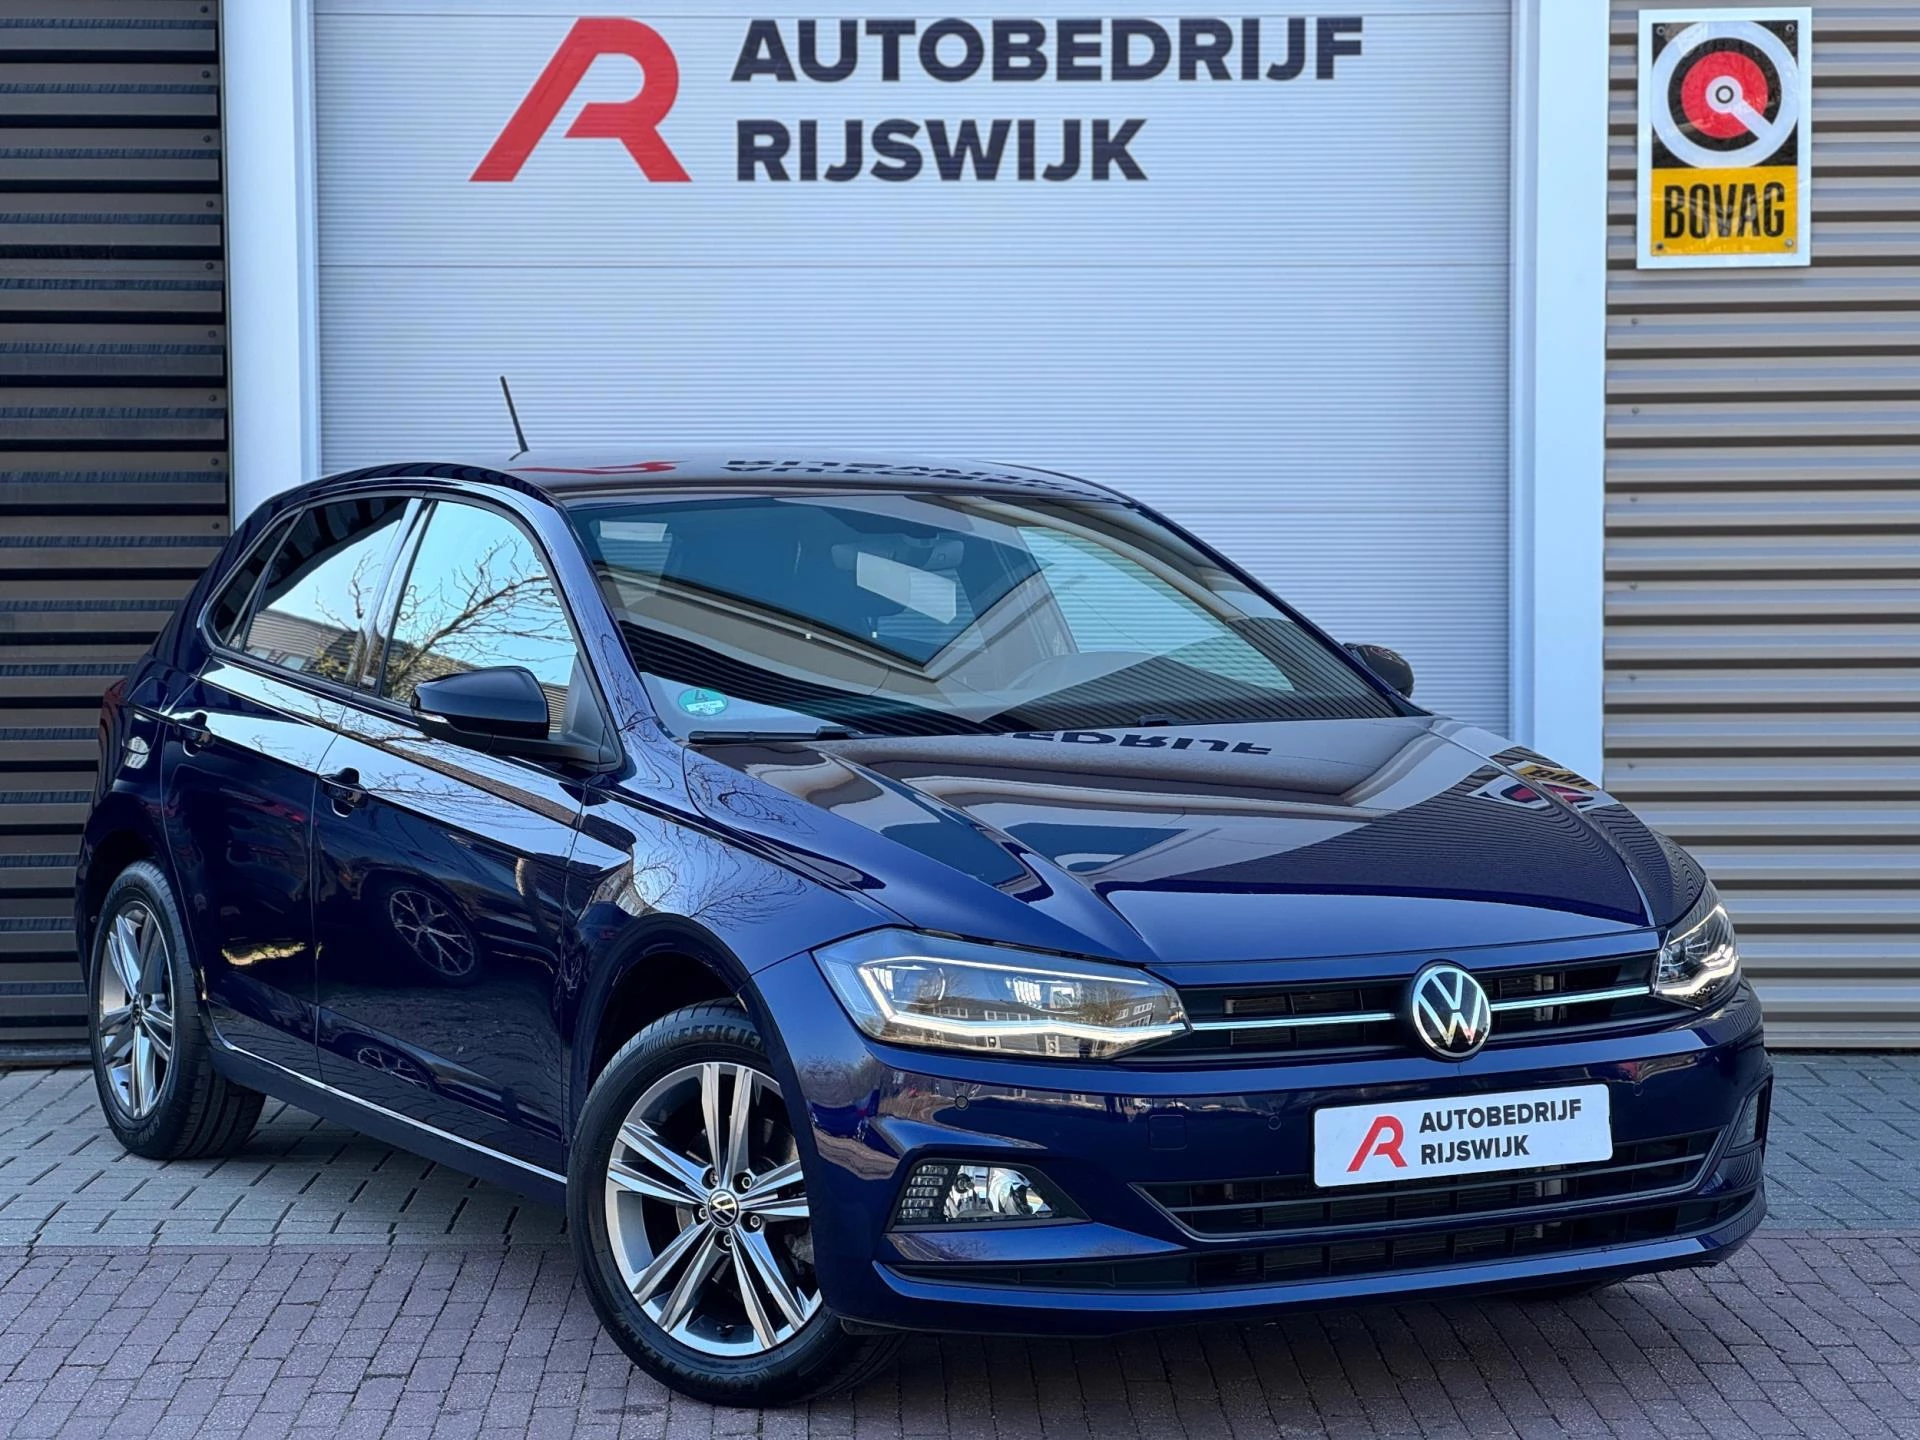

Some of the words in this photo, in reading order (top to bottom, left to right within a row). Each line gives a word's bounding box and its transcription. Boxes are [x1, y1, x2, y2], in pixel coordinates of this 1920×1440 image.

[732, 16, 1363, 82] AUTOBEDRIJF
[737, 118, 1149, 182] RIJSWIJK
[1663, 181, 1785, 239] BOVAG
[1418, 1098, 1582, 1134] AUTOBEDRIJF
[1420, 1134, 1530, 1165] RIJSWIJK
